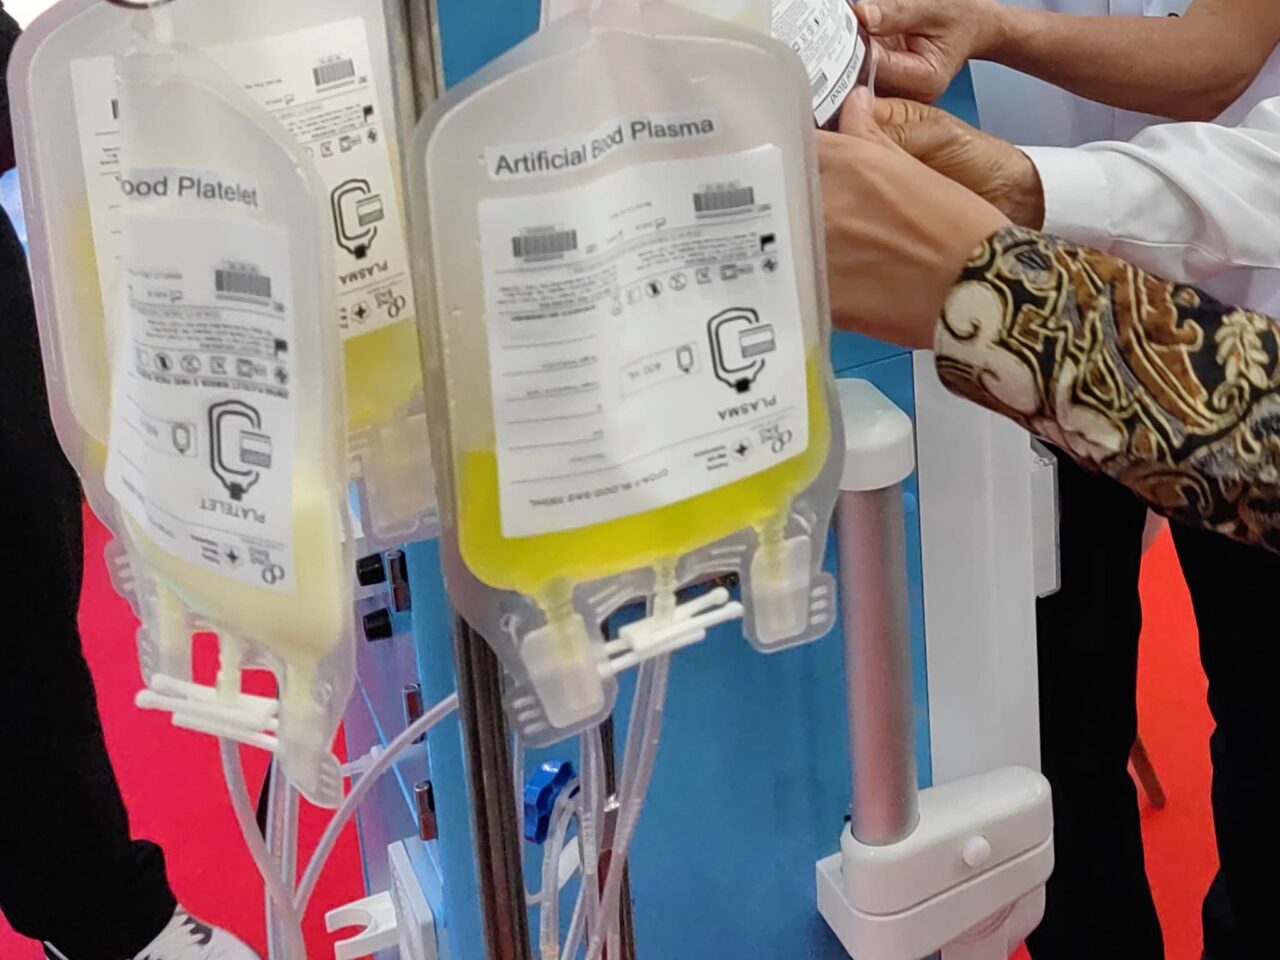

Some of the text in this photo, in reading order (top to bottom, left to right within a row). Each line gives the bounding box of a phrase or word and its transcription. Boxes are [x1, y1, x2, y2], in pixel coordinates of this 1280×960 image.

[495, 144, 587, 176] Artificial
[630, 118, 715, 141] Plasma
[178, 176, 259, 208] Platelet
[338, 260, 388, 285] PLASMA
[717, 395, 777, 421] PLASMA
[199, 498, 266, 525] PLATELET
